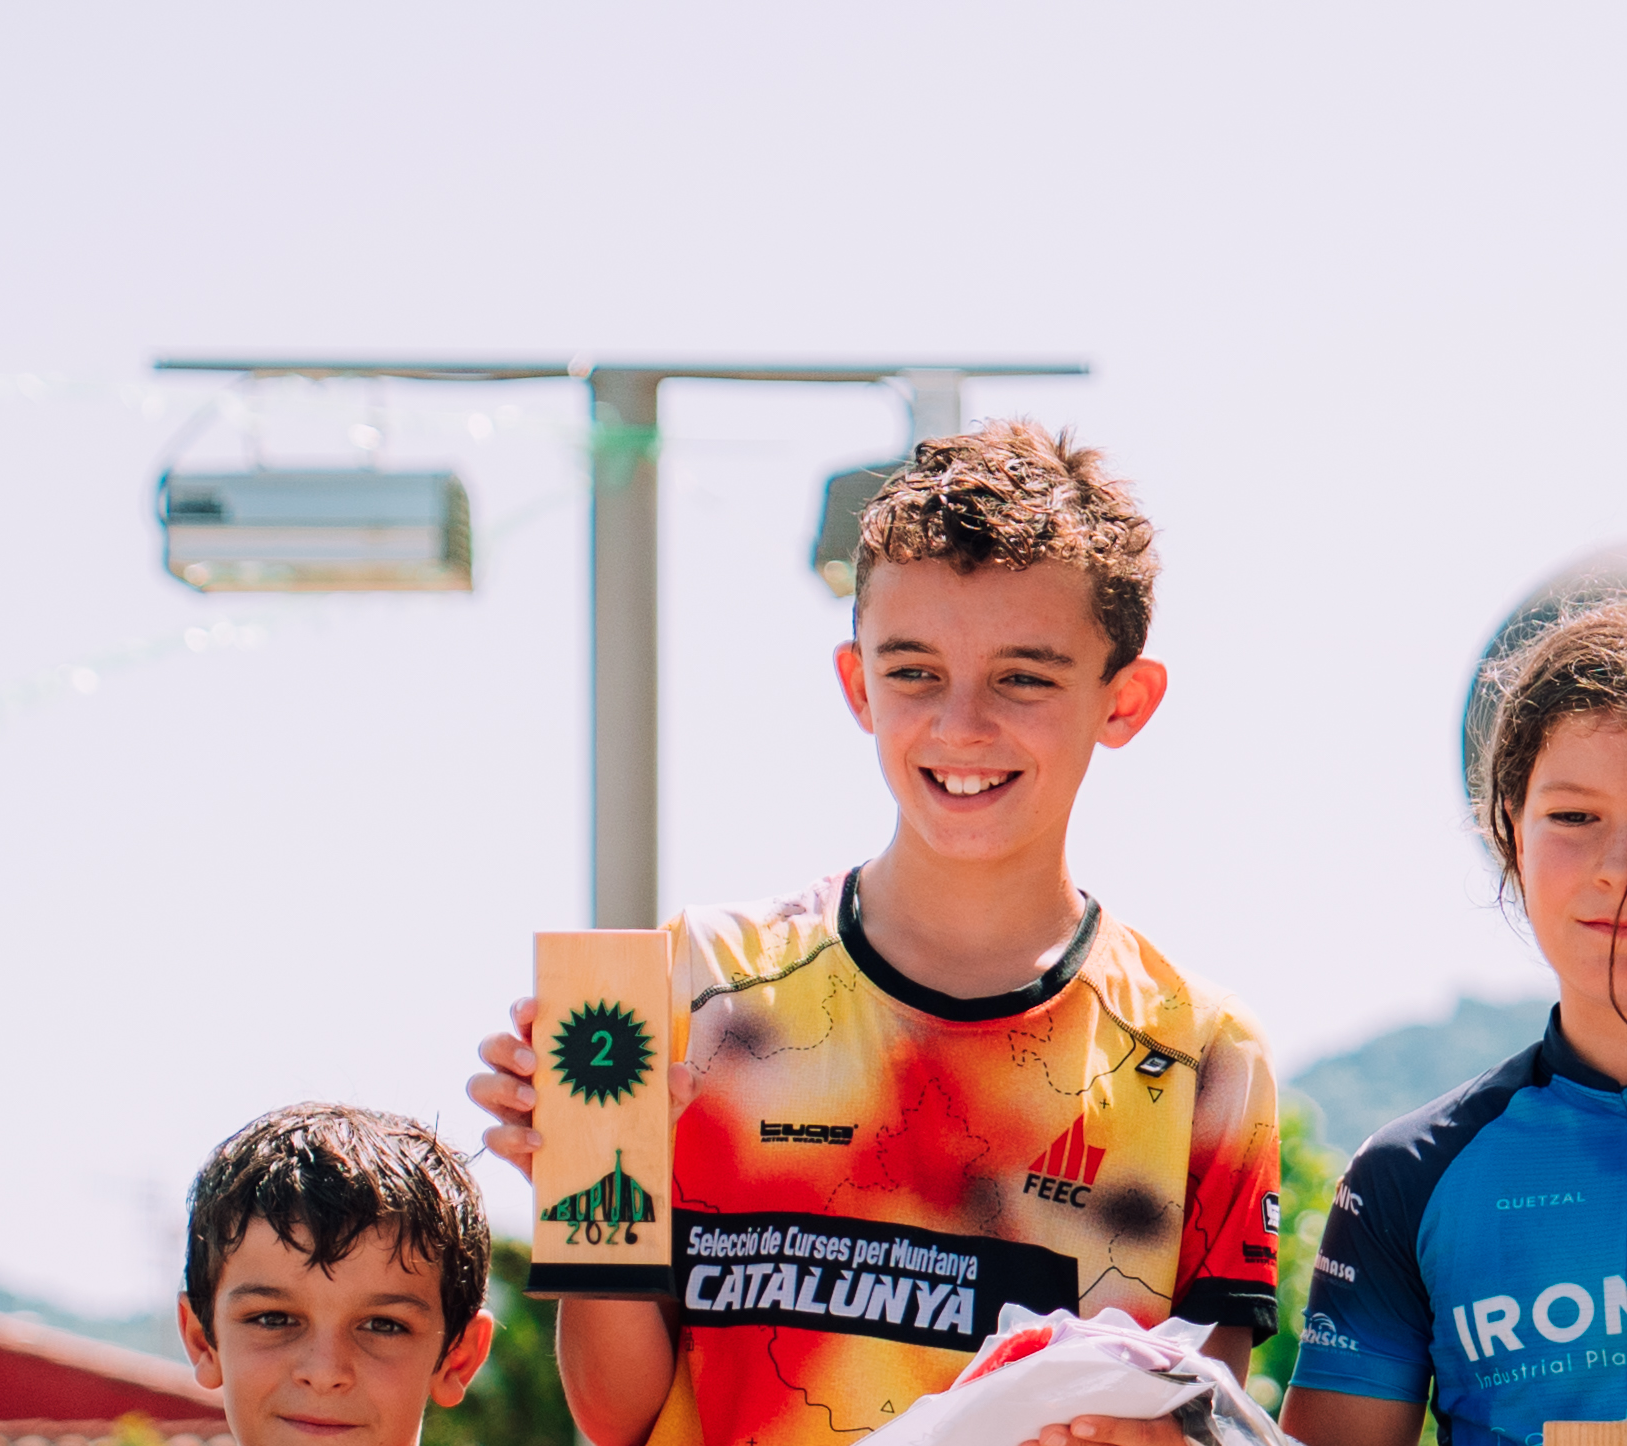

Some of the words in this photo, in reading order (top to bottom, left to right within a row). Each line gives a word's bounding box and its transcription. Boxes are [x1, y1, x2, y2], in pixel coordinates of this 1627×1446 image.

[590, 1030, 613, 1066] 2
[1023, 1172, 1091, 1209] FEEC
[1496, 1191, 1586, 1210] QUETZAL
[686, 1226, 761, 1258] Selecció
[761, 1226, 782, 1255] de
[783, 1226, 851, 1261] Curses
[852, 1239, 890, 1269] per
[890, 1238, 978, 1284] Muntanya
[685, 1263, 975, 1335] CATALUNYA
[1475, 1353, 1573, 1390] Industrial
